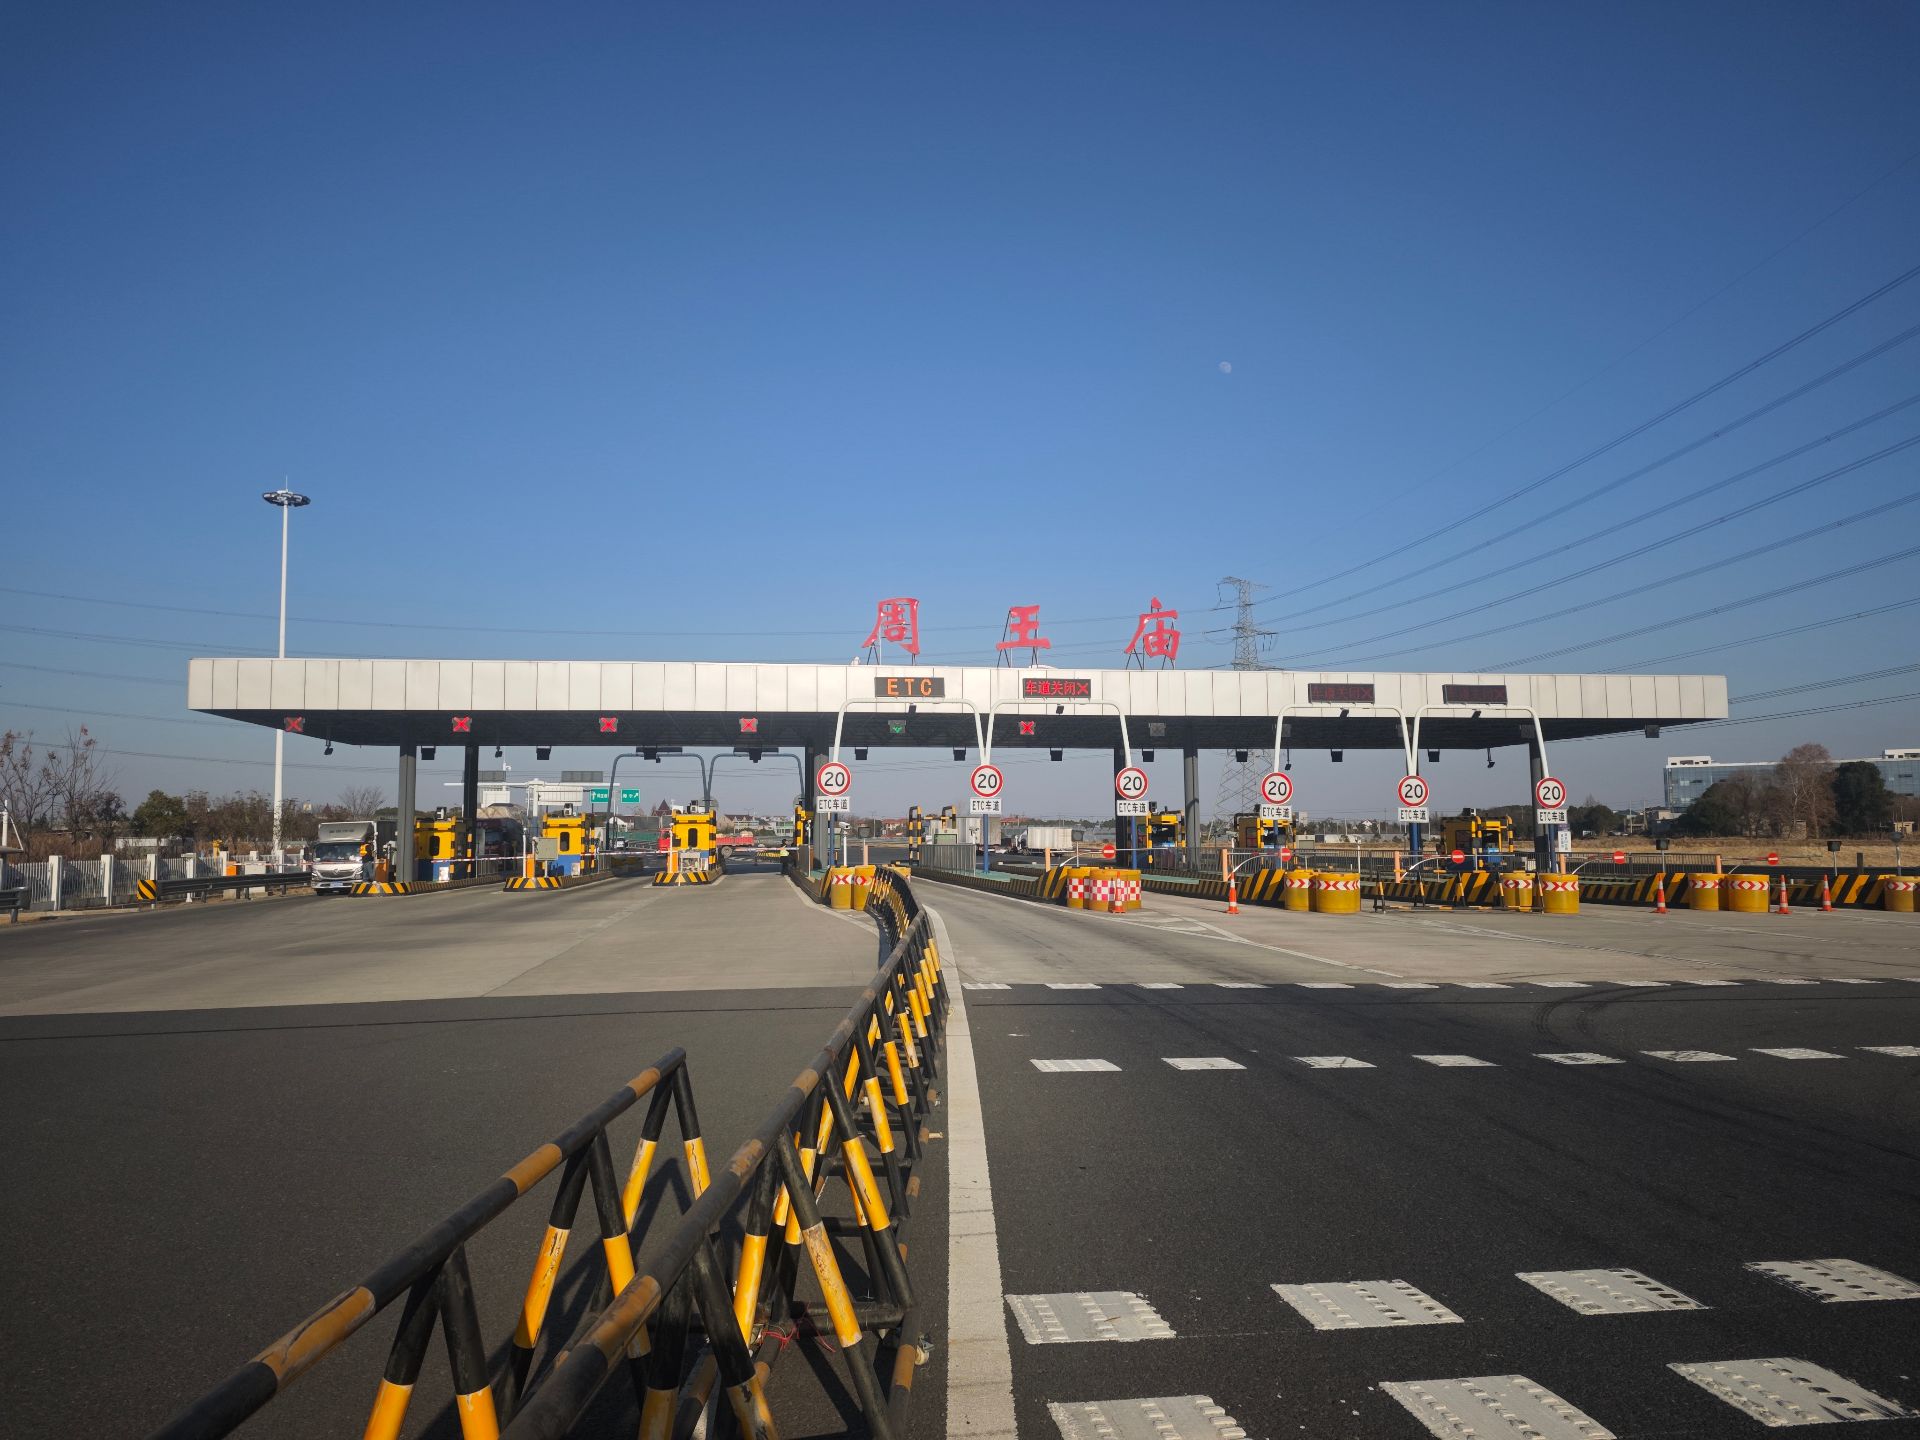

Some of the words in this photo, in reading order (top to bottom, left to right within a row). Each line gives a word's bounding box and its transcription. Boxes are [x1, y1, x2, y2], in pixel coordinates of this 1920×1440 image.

[861, 597, 1181, 660] 周王庙
[886, 678, 933, 697] ETC
[1024, 680, 1077, 696] 车道关闭
[824, 771, 846, 787] 20
[977, 773, 998, 789] 20
[1122, 776, 1143, 791] 20
[1267, 781, 1288, 796] 20
[1404, 783, 1424, 799] 20
[1542, 786, 1561, 801] 20
[818, 798, 848, 811] ETC车道
[972, 800, 1000, 812] ETC车道
